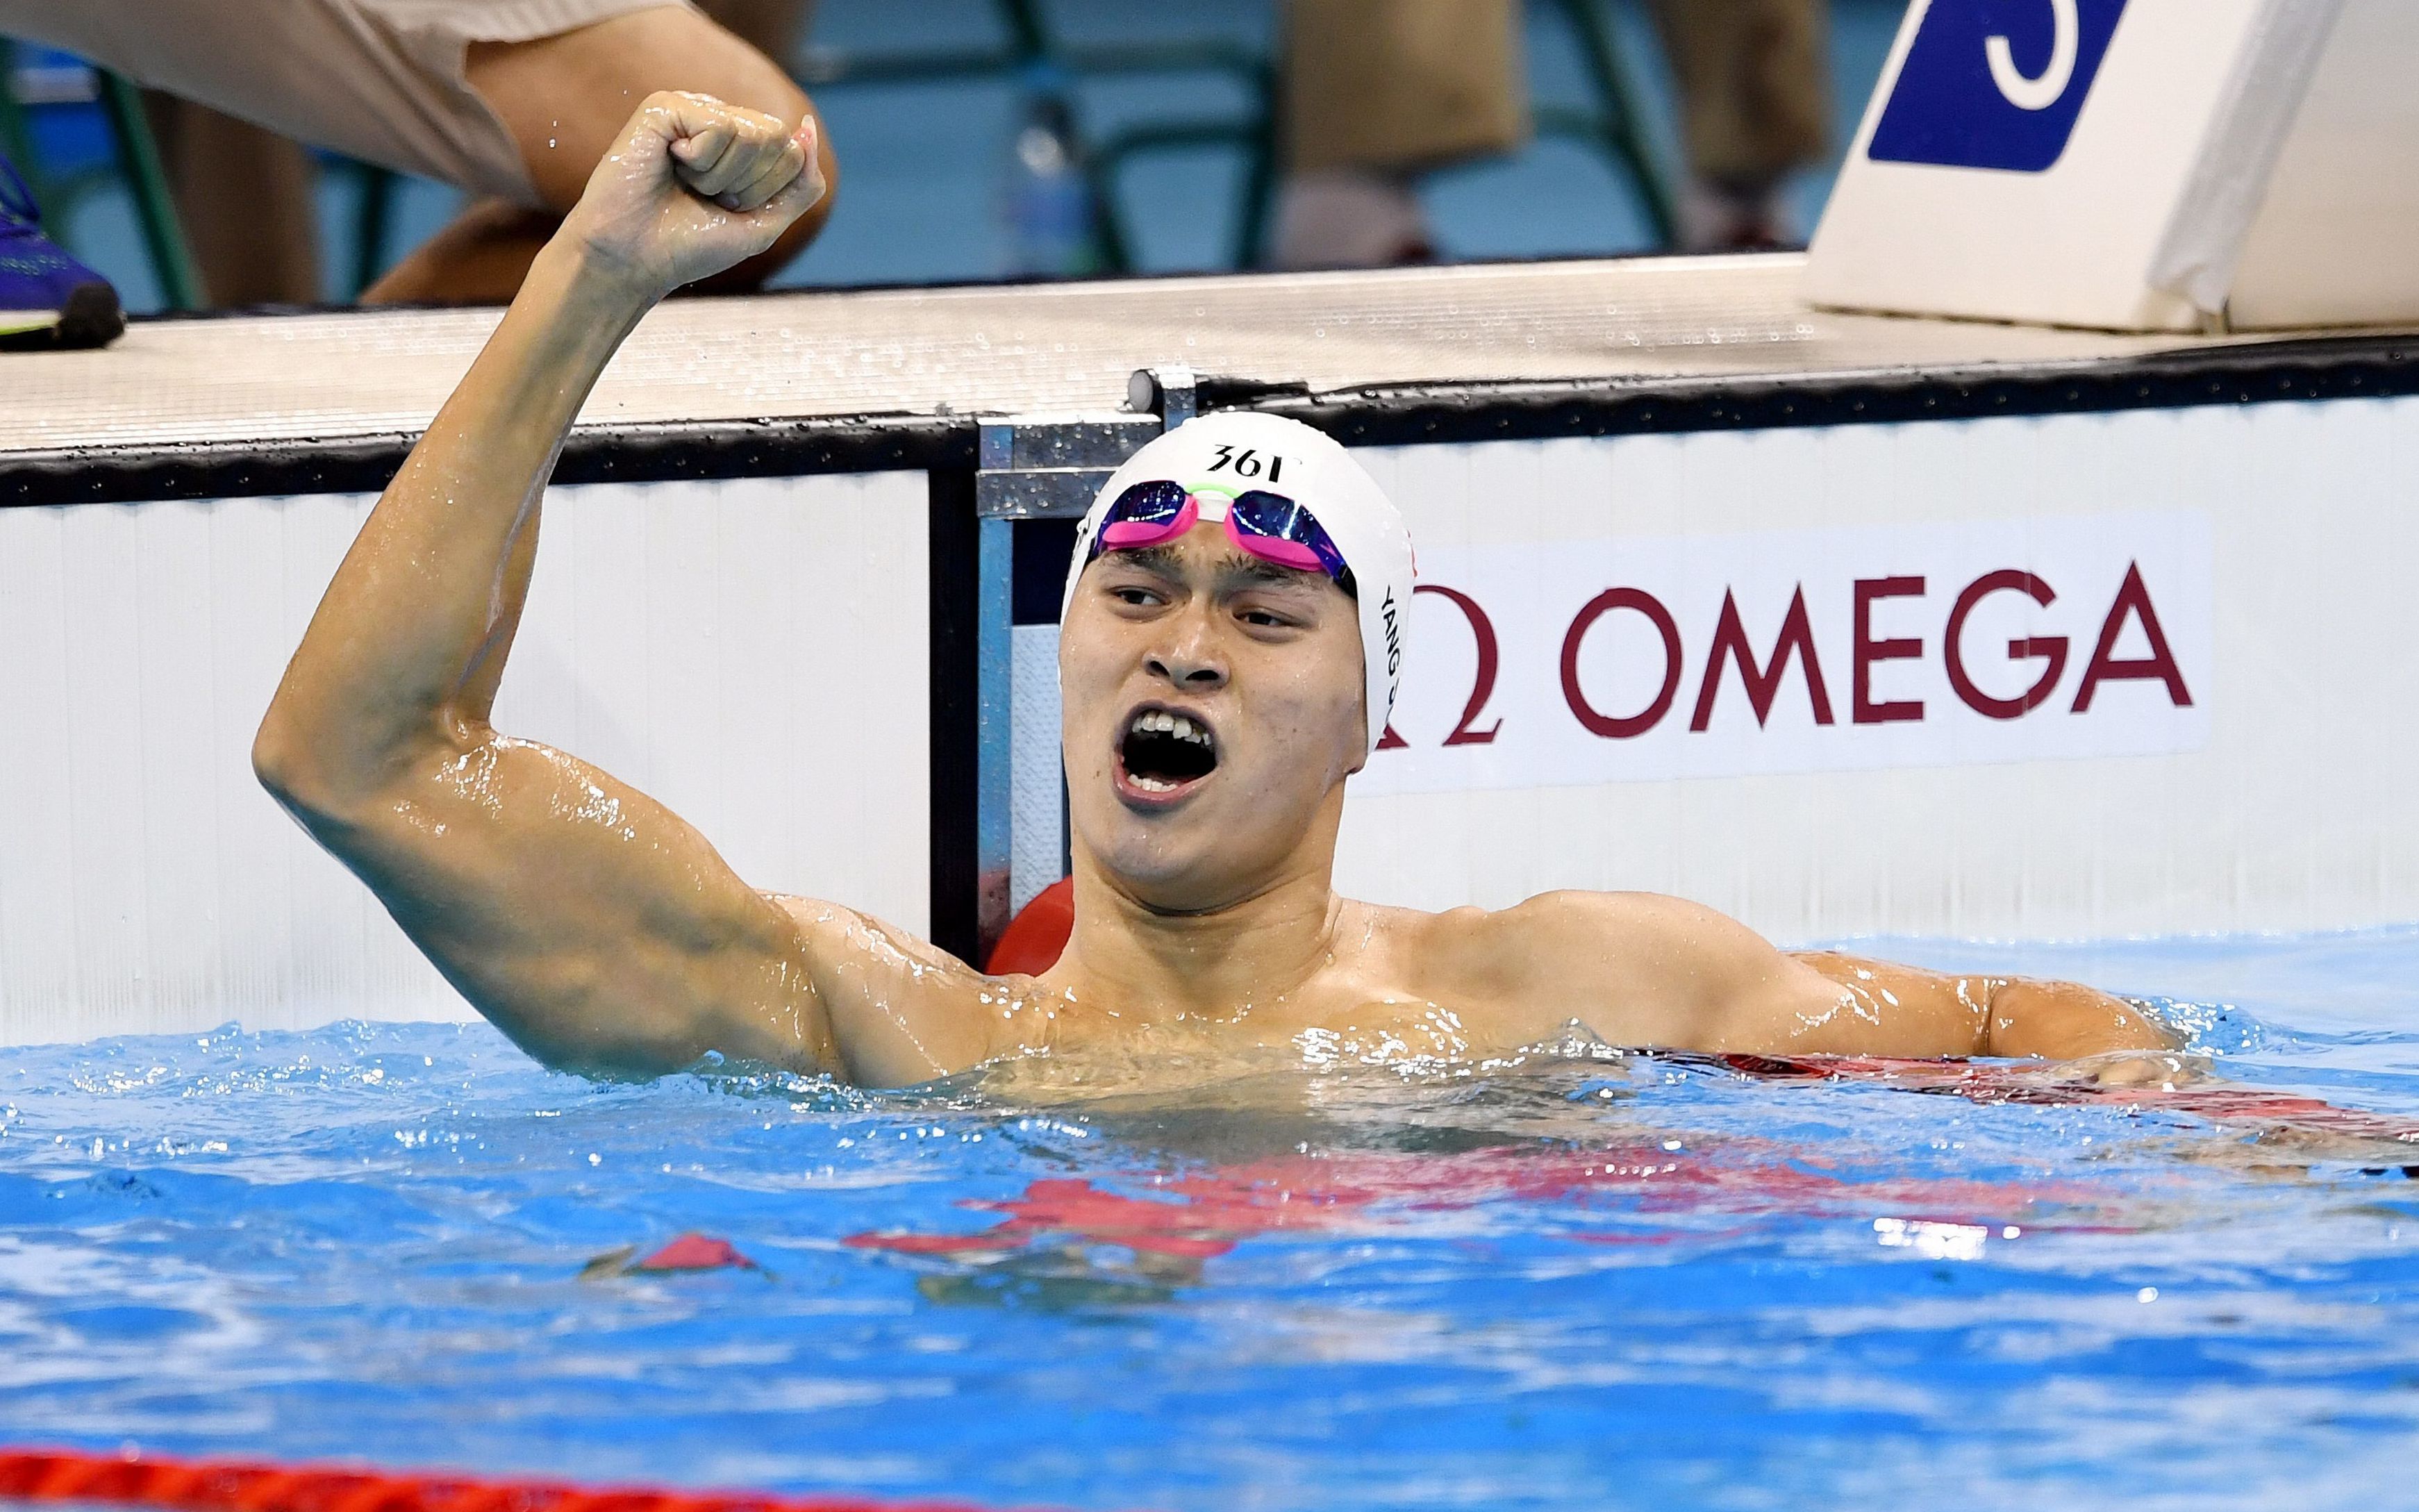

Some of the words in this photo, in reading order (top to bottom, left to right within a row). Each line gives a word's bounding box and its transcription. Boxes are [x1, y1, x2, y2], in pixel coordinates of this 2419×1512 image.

[1207, 444, 1303, 483] 361
[1381, 584, 1400, 677] YANG
[1560, 558, 2194, 740] OMEGA
